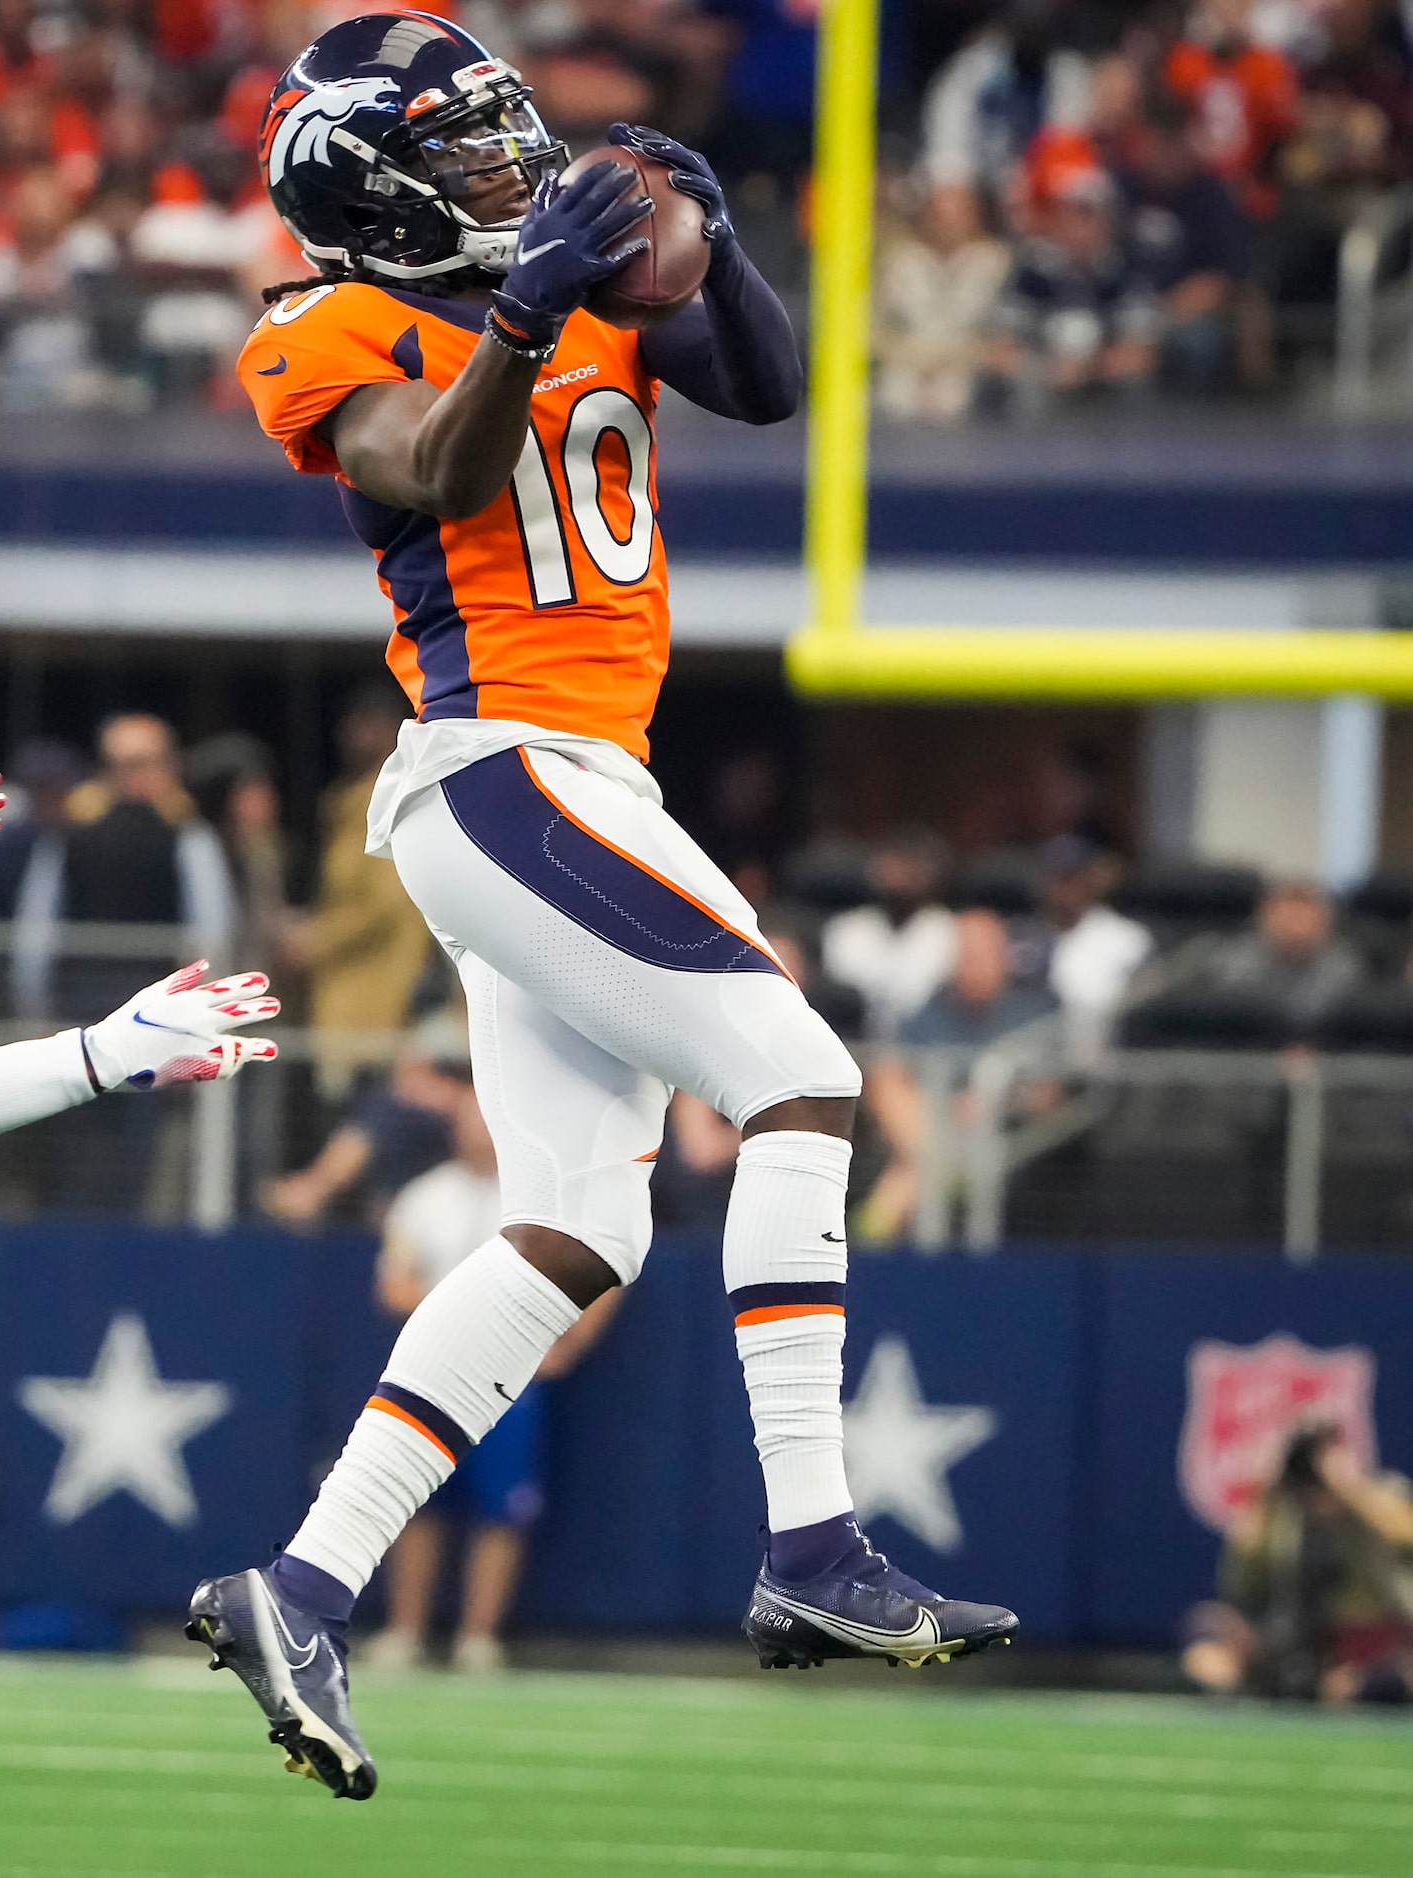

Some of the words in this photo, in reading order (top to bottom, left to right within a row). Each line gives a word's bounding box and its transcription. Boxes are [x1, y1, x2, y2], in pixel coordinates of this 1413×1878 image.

[531, 363, 599, 394] RONCOS
[509, 386, 656, 610] 10
[749, 1605, 794, 1632] VAPOR
